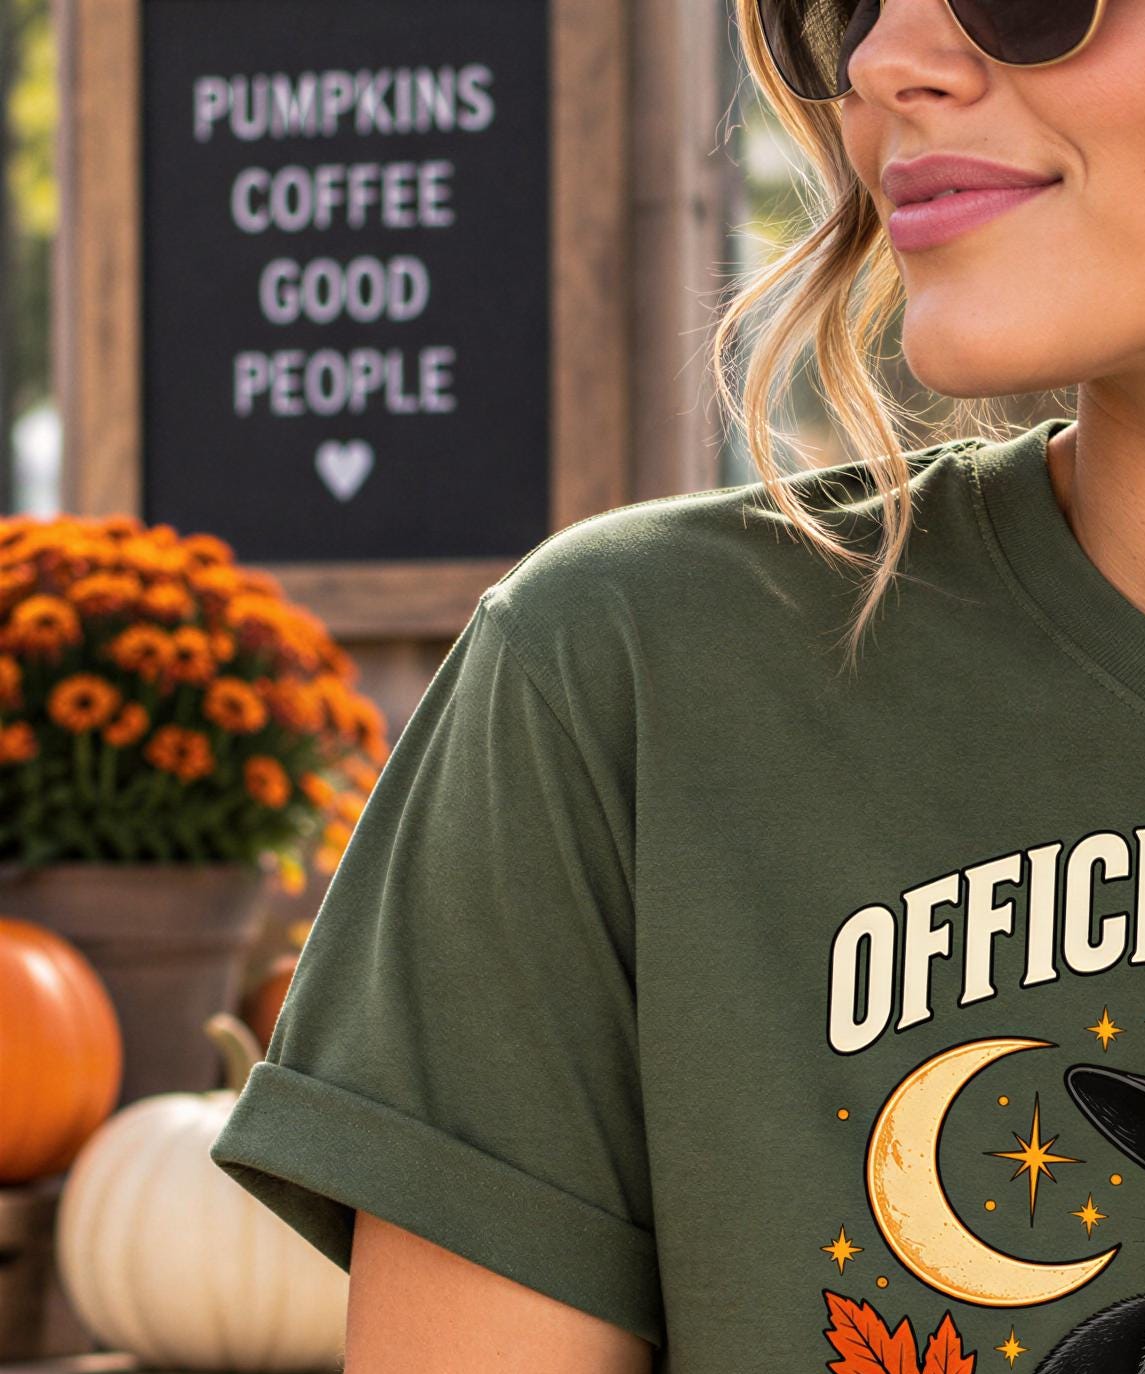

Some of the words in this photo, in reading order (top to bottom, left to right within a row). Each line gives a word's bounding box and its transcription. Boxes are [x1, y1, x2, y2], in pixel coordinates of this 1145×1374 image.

[194, 64, 494, 140] PUMPKINS
[231, 161, 455, 233] COFFEE
[259, 256, 429, 324] GOOD
[234, 347, 456, 416] PEOPLE
